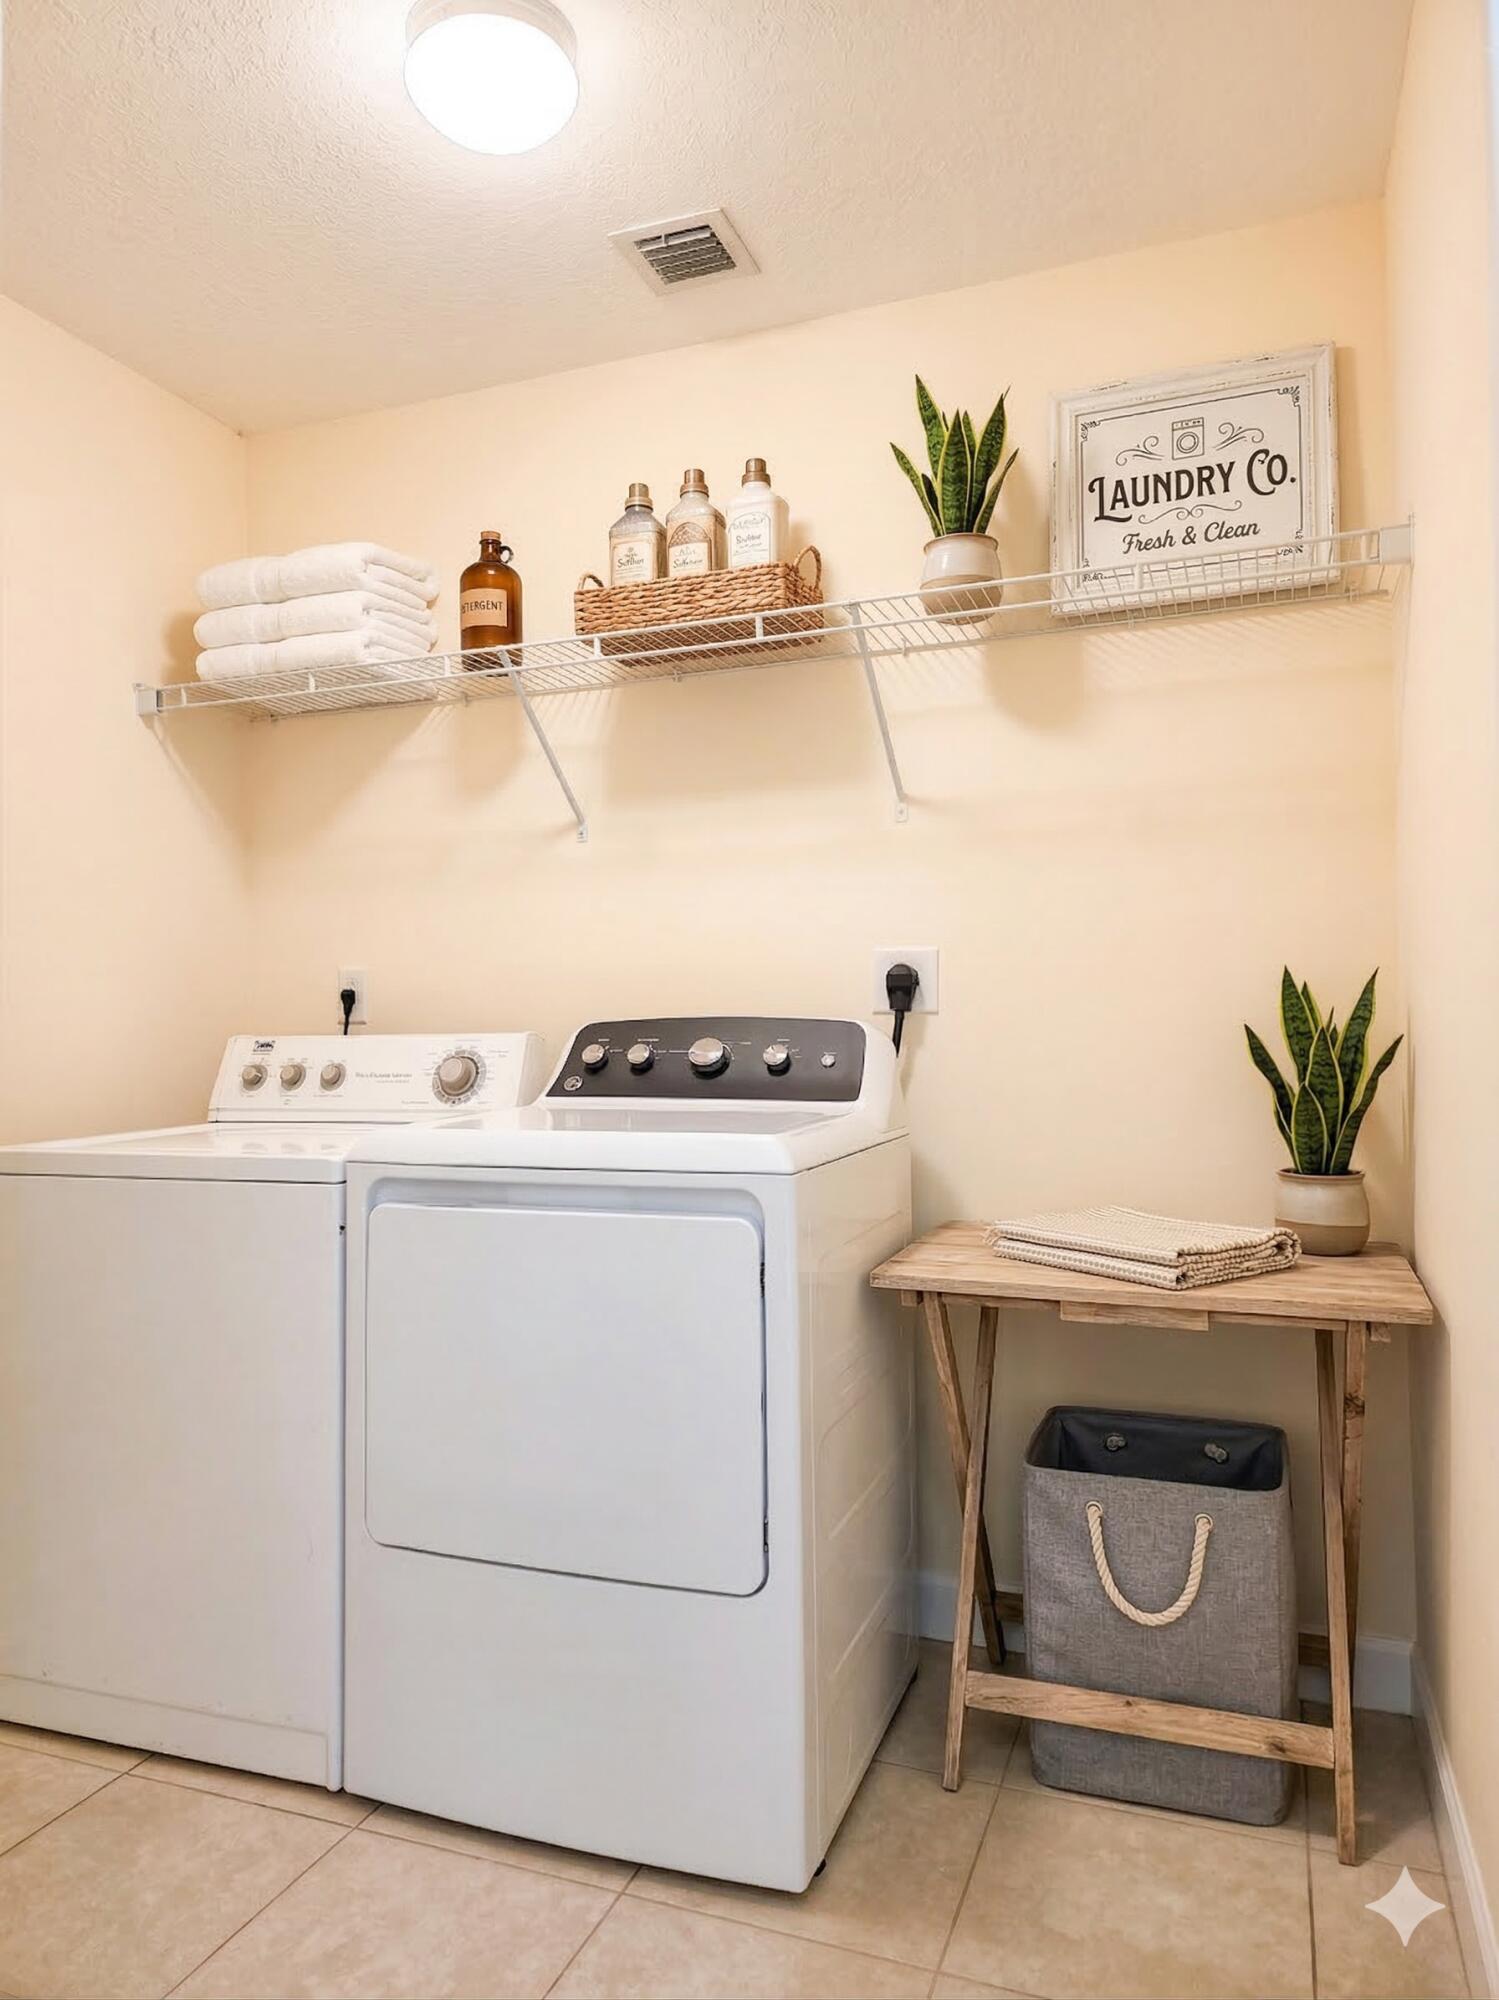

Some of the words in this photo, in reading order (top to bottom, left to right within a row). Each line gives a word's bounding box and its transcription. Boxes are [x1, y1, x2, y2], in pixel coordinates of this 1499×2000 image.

[1088, 461, 1236, 523] LAUNDRY
[1122, 529, 1177, 555] Fresh
[1181, 526, 1197, 546] &
[1203, 521, 1261, 543] Clean
